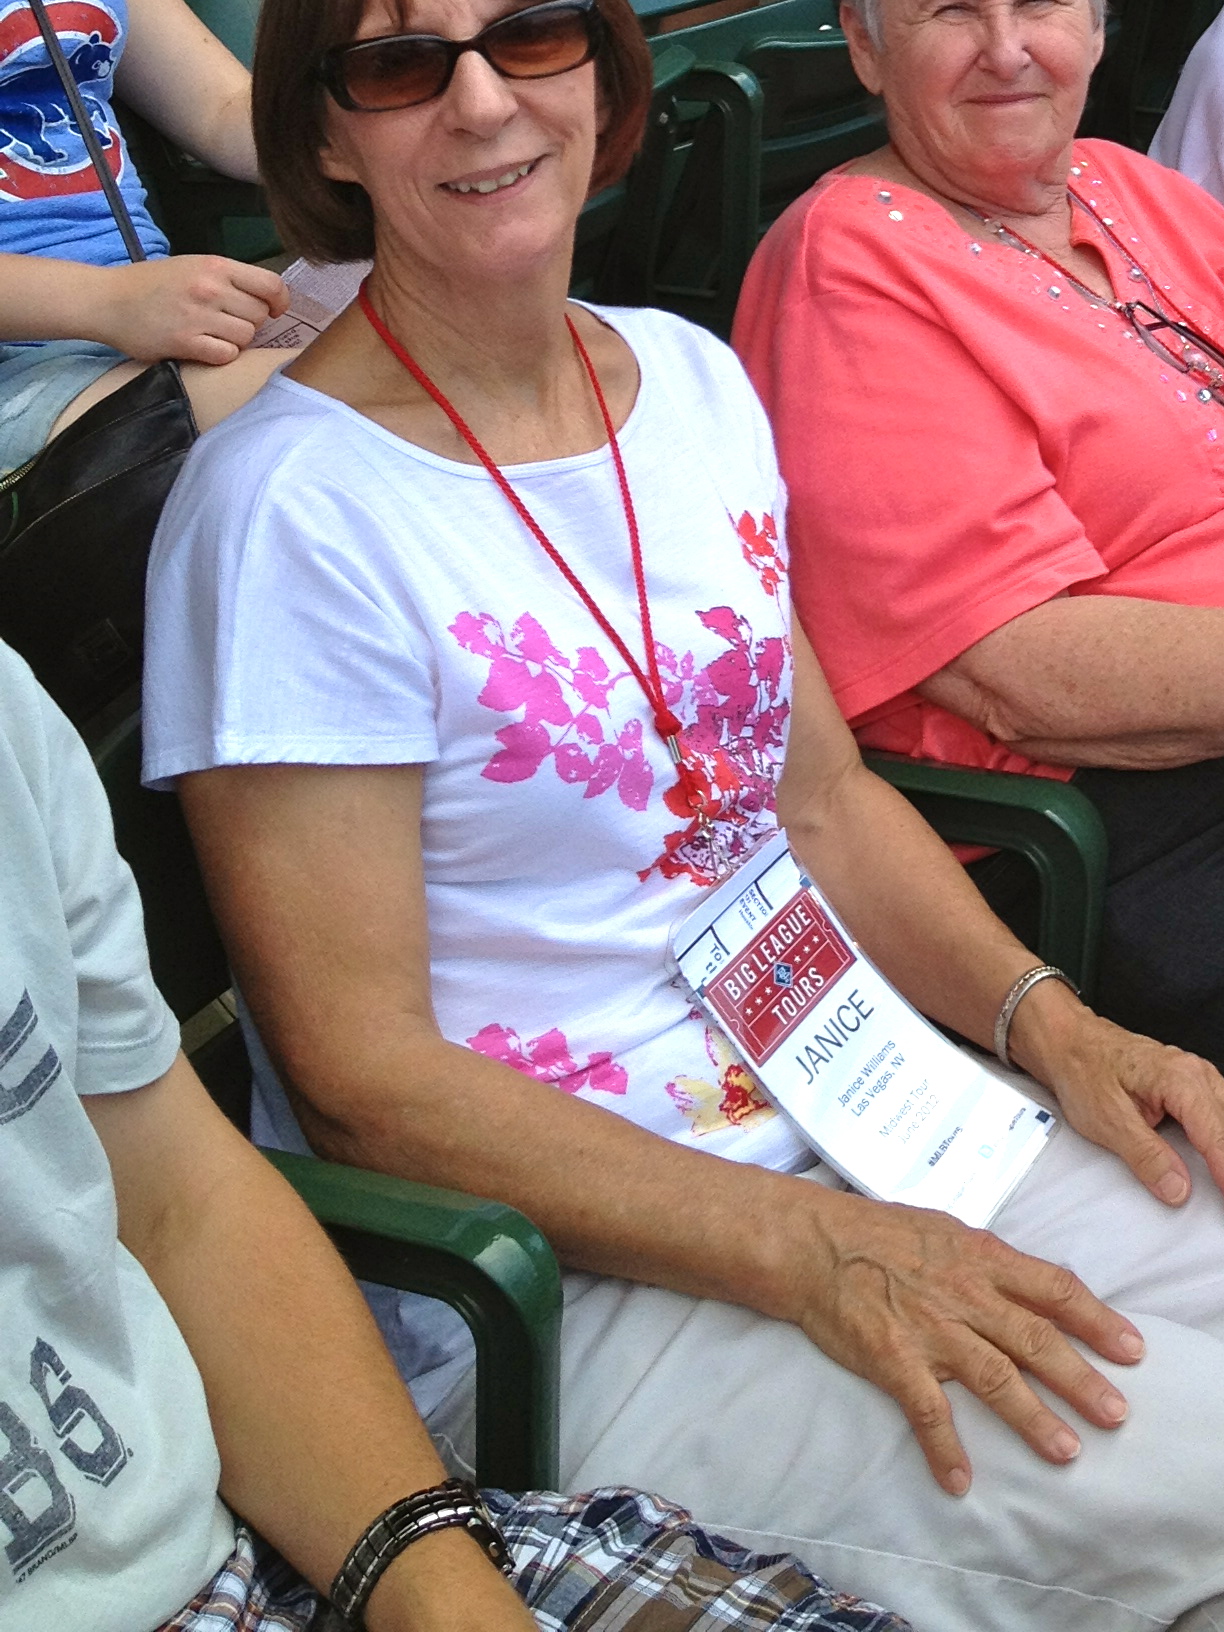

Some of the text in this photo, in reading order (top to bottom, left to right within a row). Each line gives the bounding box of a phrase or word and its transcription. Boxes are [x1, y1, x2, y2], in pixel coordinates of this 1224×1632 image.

[723, 904, 812, 1001] BIG LEAGUE
[771, 966, 825, 1026] TOURS
[795, 988, 875, 1086] JANICE
[837, 1039, 897, 1108] Janice Williams
[850, 1052, 906, 1118] Las Vegas, NV
[878, 1078, 930, 1138] Midwest Tour
